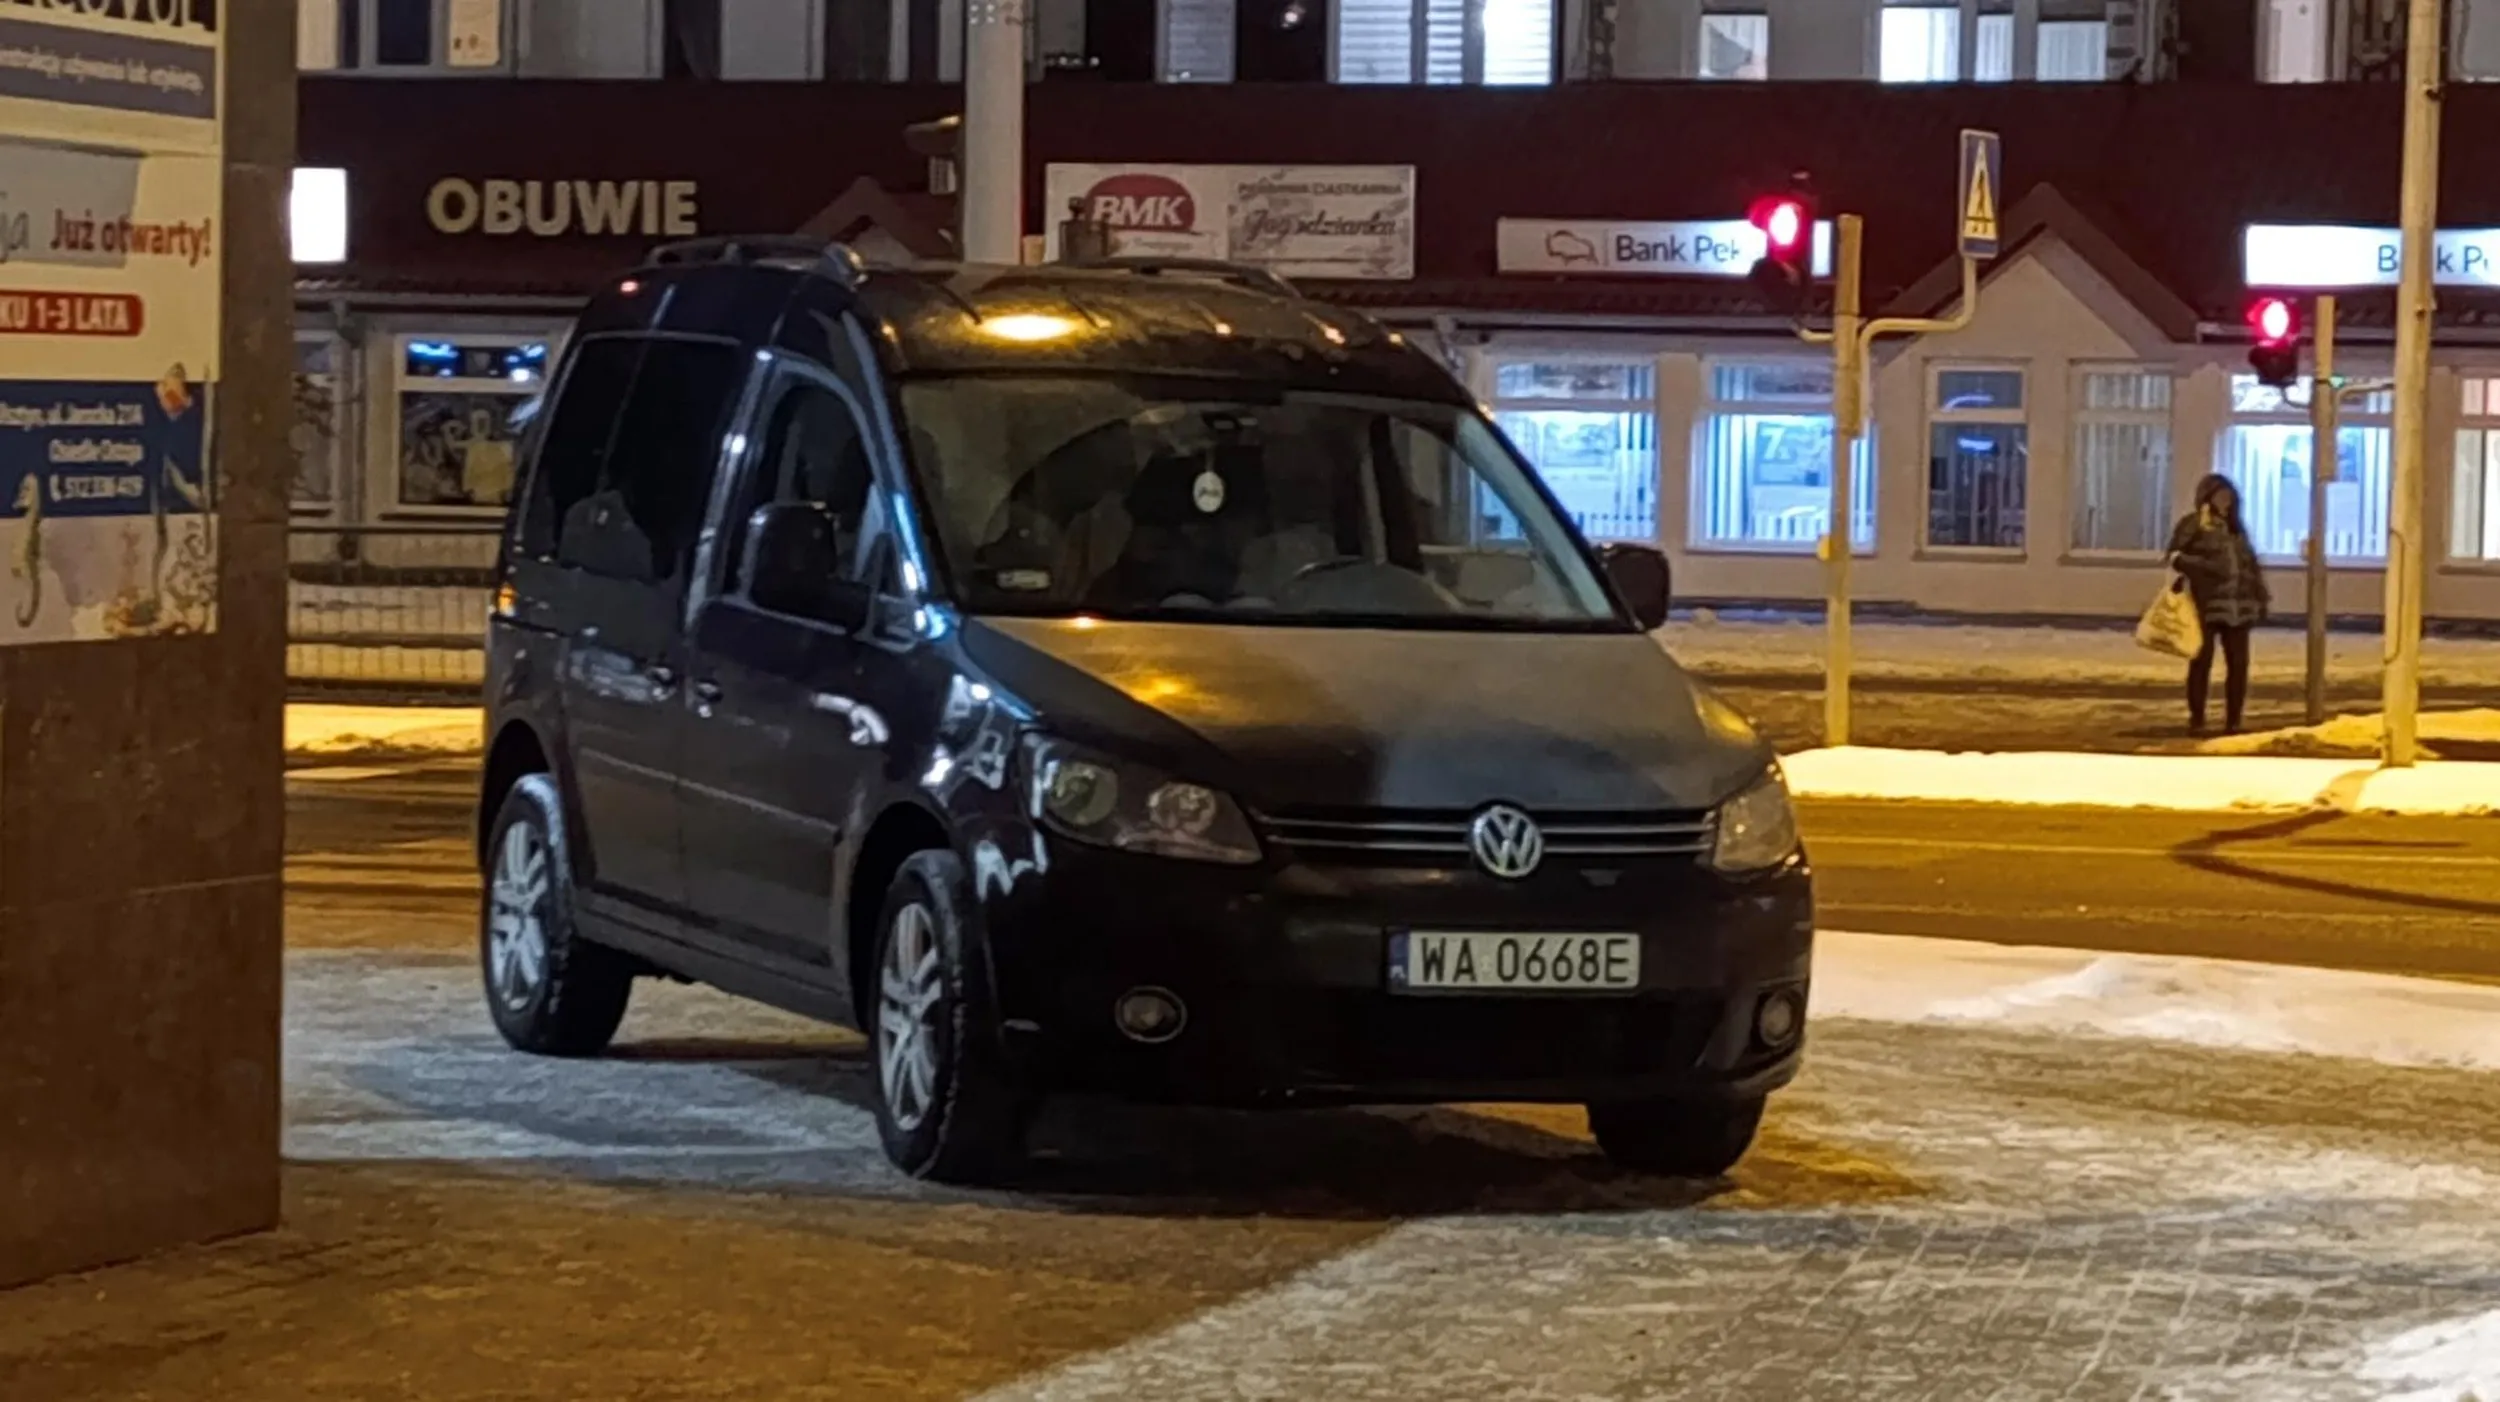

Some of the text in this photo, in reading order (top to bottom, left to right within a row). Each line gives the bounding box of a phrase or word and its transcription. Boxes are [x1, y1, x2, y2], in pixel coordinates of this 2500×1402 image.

[427, 177, 698, 236] OBUWIE
[1092, 195, 1187, 226] BMK
[50, 208, 212, 268] Już otwarty!
[1615, 235, 1687, 262] Bank
[2377, 243, 2455, 273] Bk
[75, 298, 130, 331] LATA
[1420, 937, 1630, 983] WA 0668E
